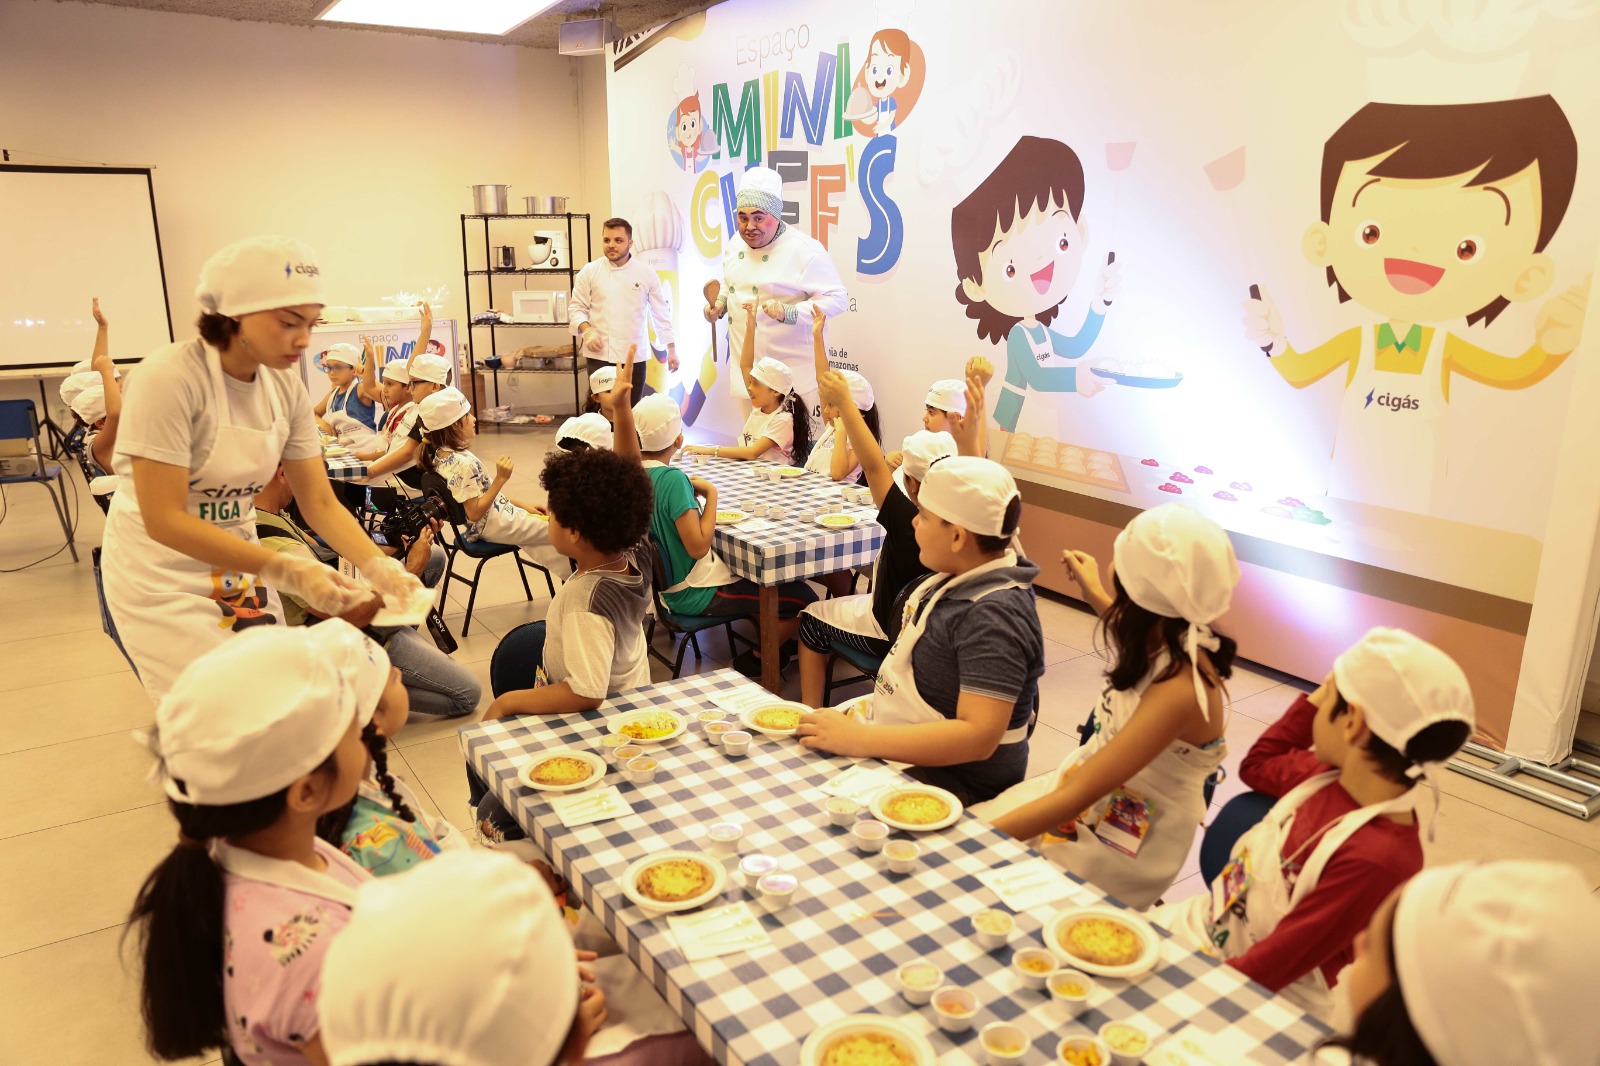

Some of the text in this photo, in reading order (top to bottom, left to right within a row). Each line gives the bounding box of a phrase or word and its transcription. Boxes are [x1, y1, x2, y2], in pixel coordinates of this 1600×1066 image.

[736, 23, 810, 68] Espaço
[712, 42, 854, 163] MINI
[358, 333, 399, 345] Espaço
[828, 360, 859, 372] mazonas
[1376, 392, 1420, 412] cigás
